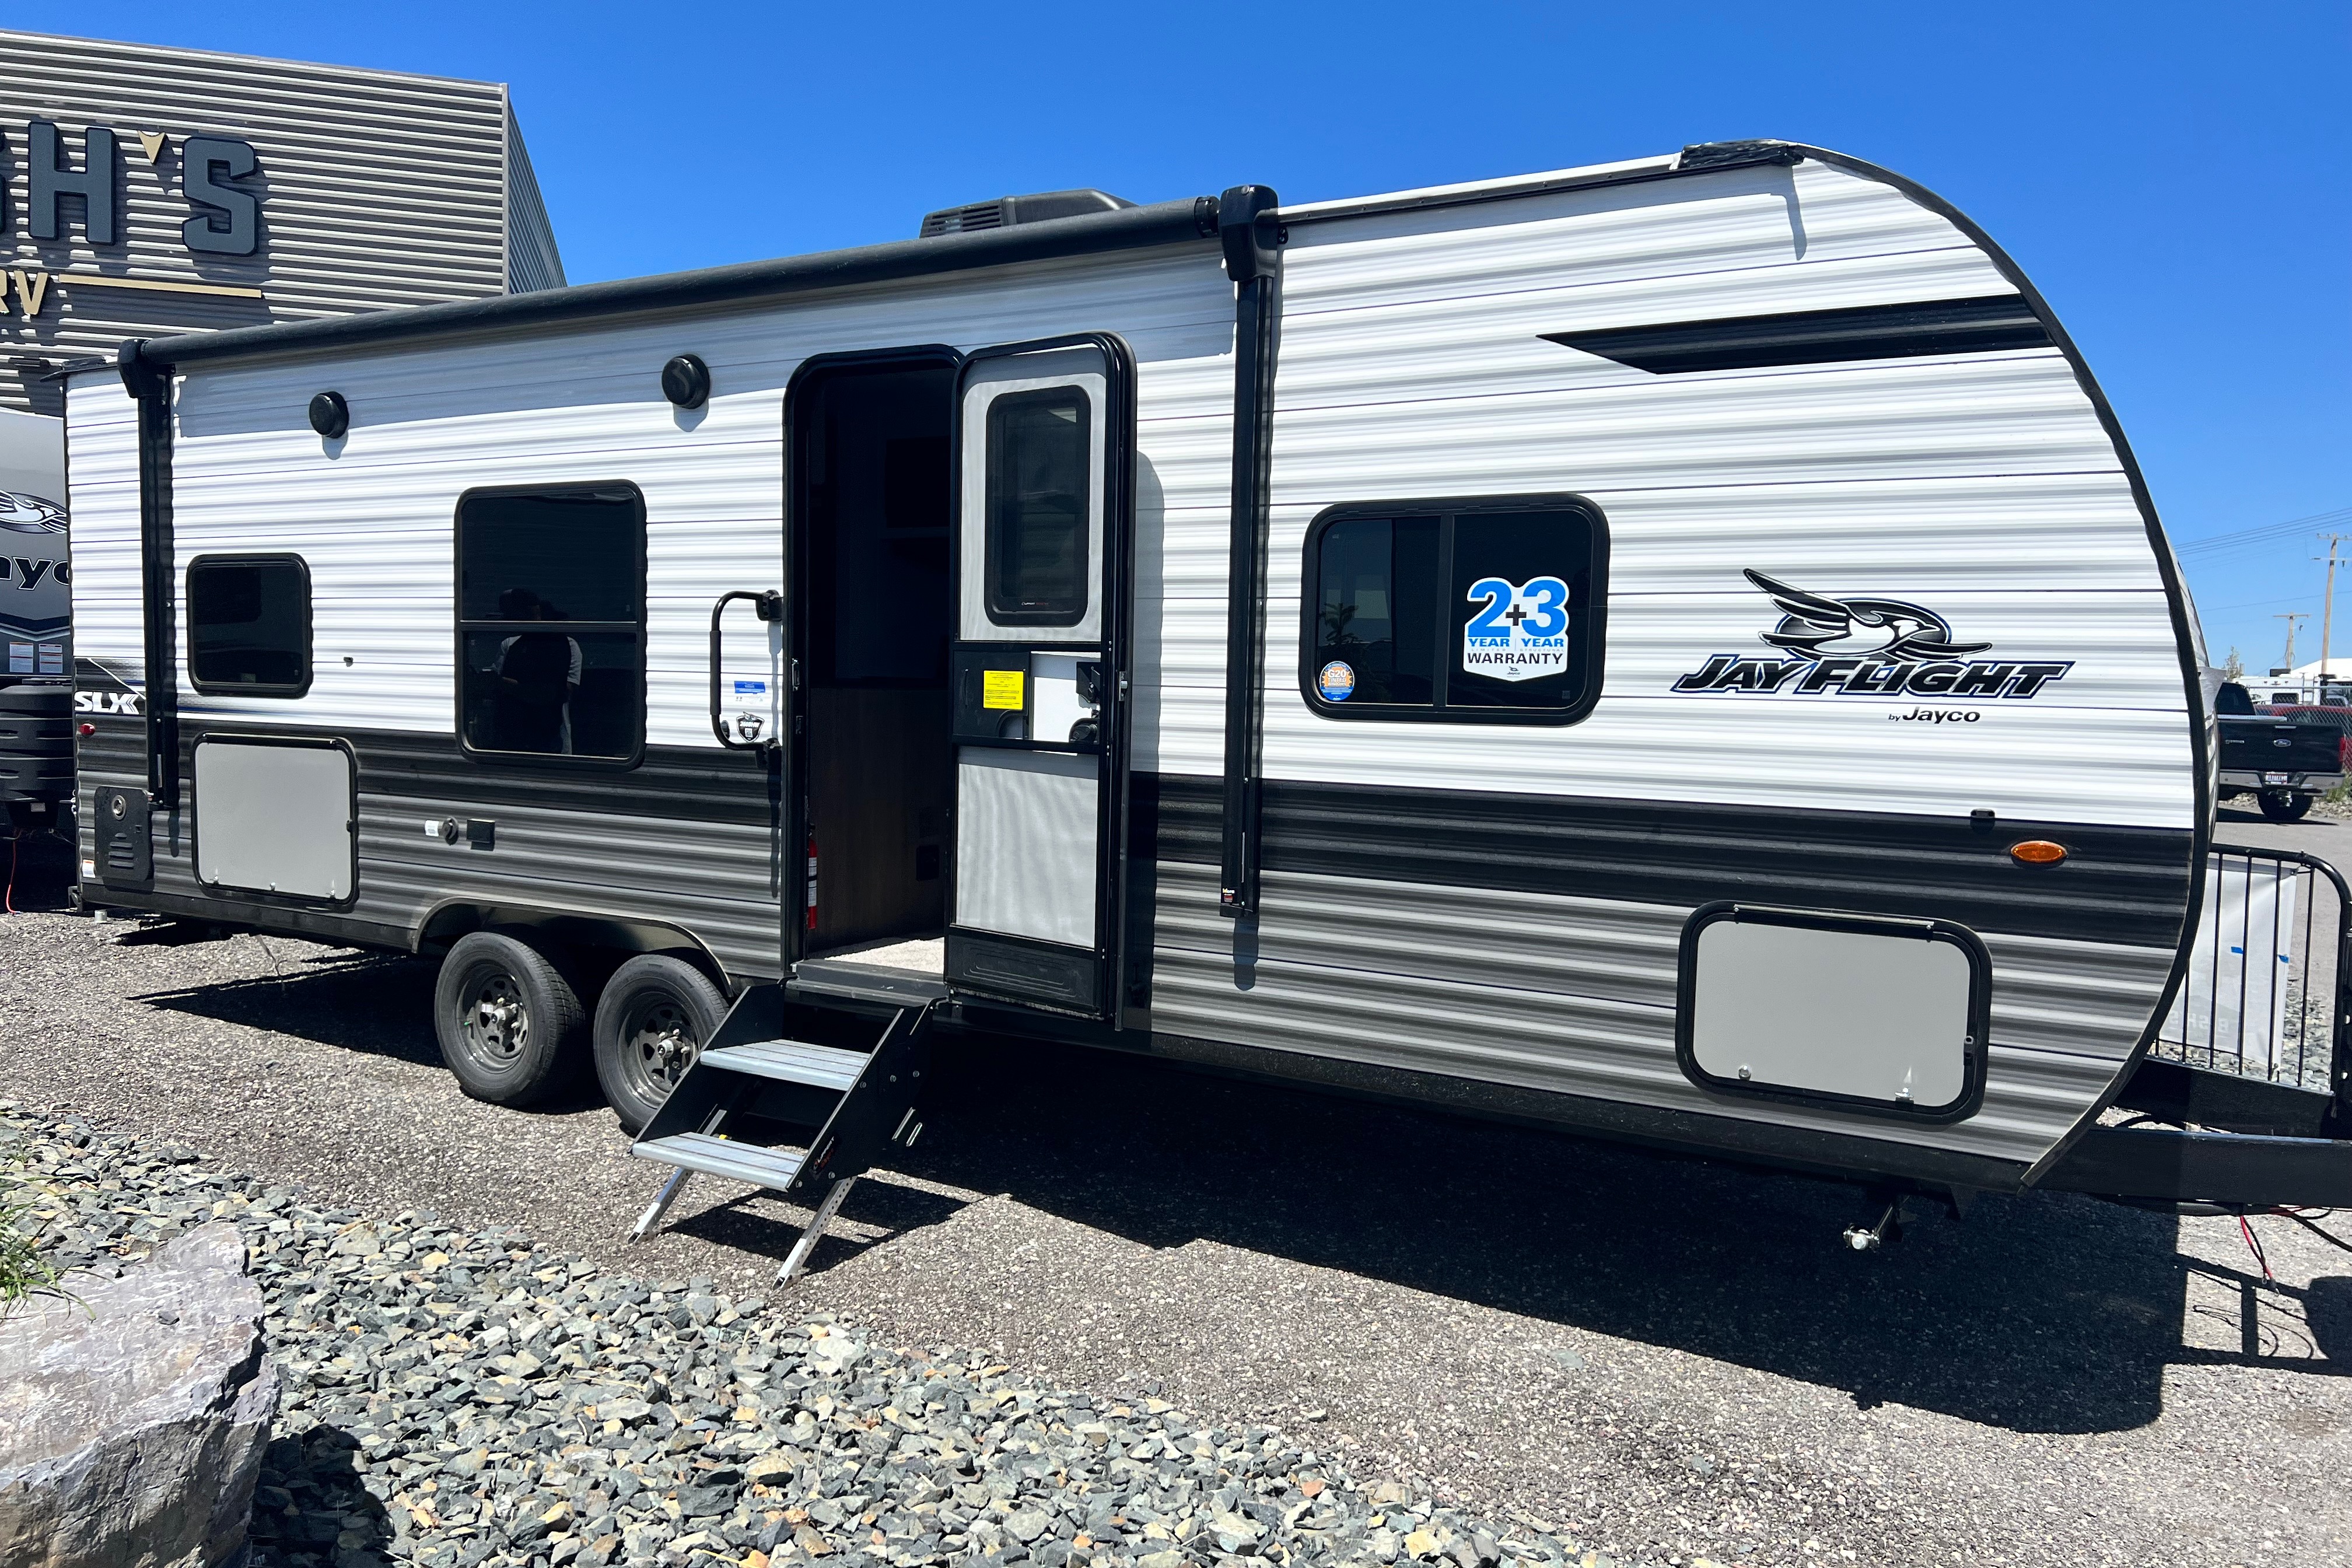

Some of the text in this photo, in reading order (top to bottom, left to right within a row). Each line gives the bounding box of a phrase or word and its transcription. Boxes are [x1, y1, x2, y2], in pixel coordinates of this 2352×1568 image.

[0, 121, 258, 257] H'S
[1468, 638, 1564, 647] YEAR YEAR
[1467, 653, 1563, 664] WARRANTY
[1328, 669, 1347, 678] G20
[1670, 654, 2076, 699] JAY FLIGHT
[74, 691, 140, 715] SLX
[1888, 706, 1980, 724] by Jayco
